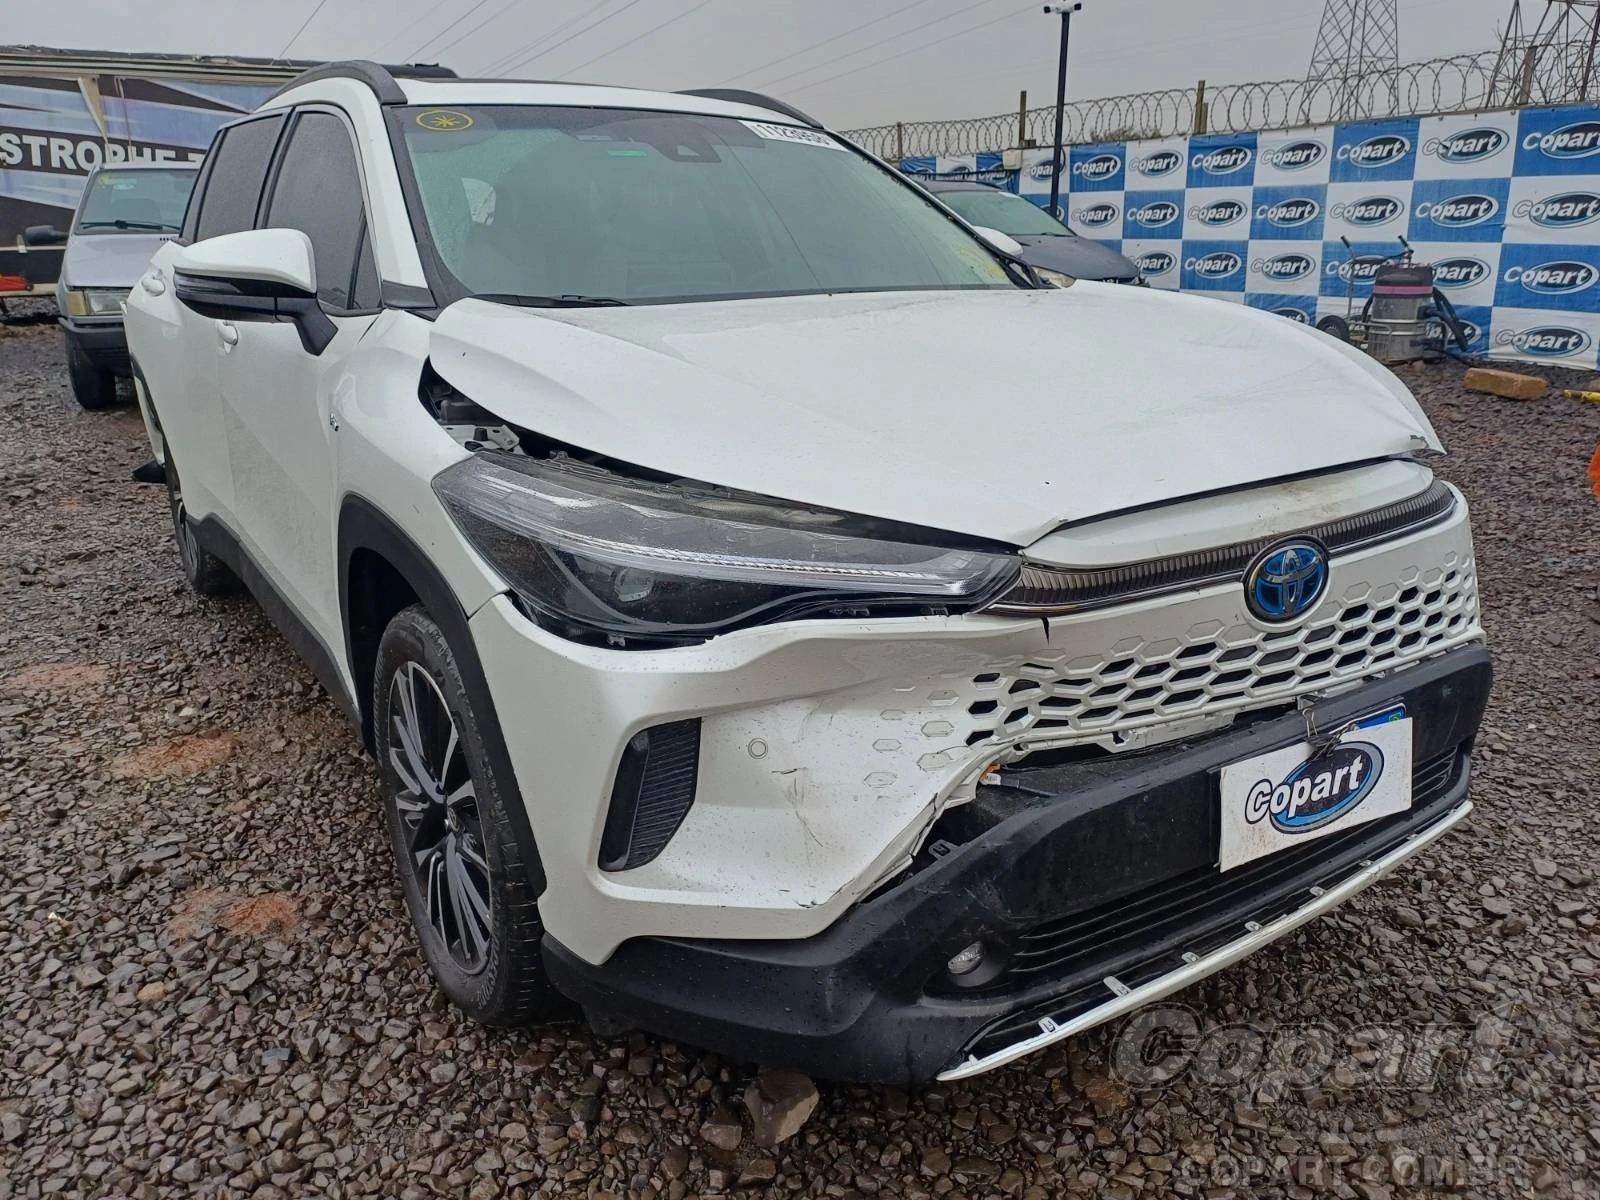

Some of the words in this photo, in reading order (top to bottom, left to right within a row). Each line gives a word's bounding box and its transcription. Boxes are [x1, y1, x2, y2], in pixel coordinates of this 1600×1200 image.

[1336, 138, 1405, 161] Copart
[1422, 131, 1498, 156] Copart
[1522, 130, 1600, 151] Copar
[1129, 154, 1177, 173] Copart
[1191, 149, 1247, 170] Copart
[1261, 144, 1319, 165] Copart
[1073, 157, 1115, 178] Copart
[1071, 205, 1114, 225] Copart
[1126, 203, 1174, 225] Copart
[1188, 201, 1241, 223] Copart
[1256, 200, 1314, 223] Copart
[1330, 197, 1395, 220] Copart
[1415, 196, 1492, 221] Copart
[1512, 197, 1600, 221] Copart
[1130, 256, 1170, 271] opart
[1184, 252, 1235, 273] Copart
[1251, 255, 1308, 277] Copart
[1503, 265, 1592, 287] Copart
[1495, 328, 1581, 351] Copart
[1245, 752, 1364, 825] Copart
